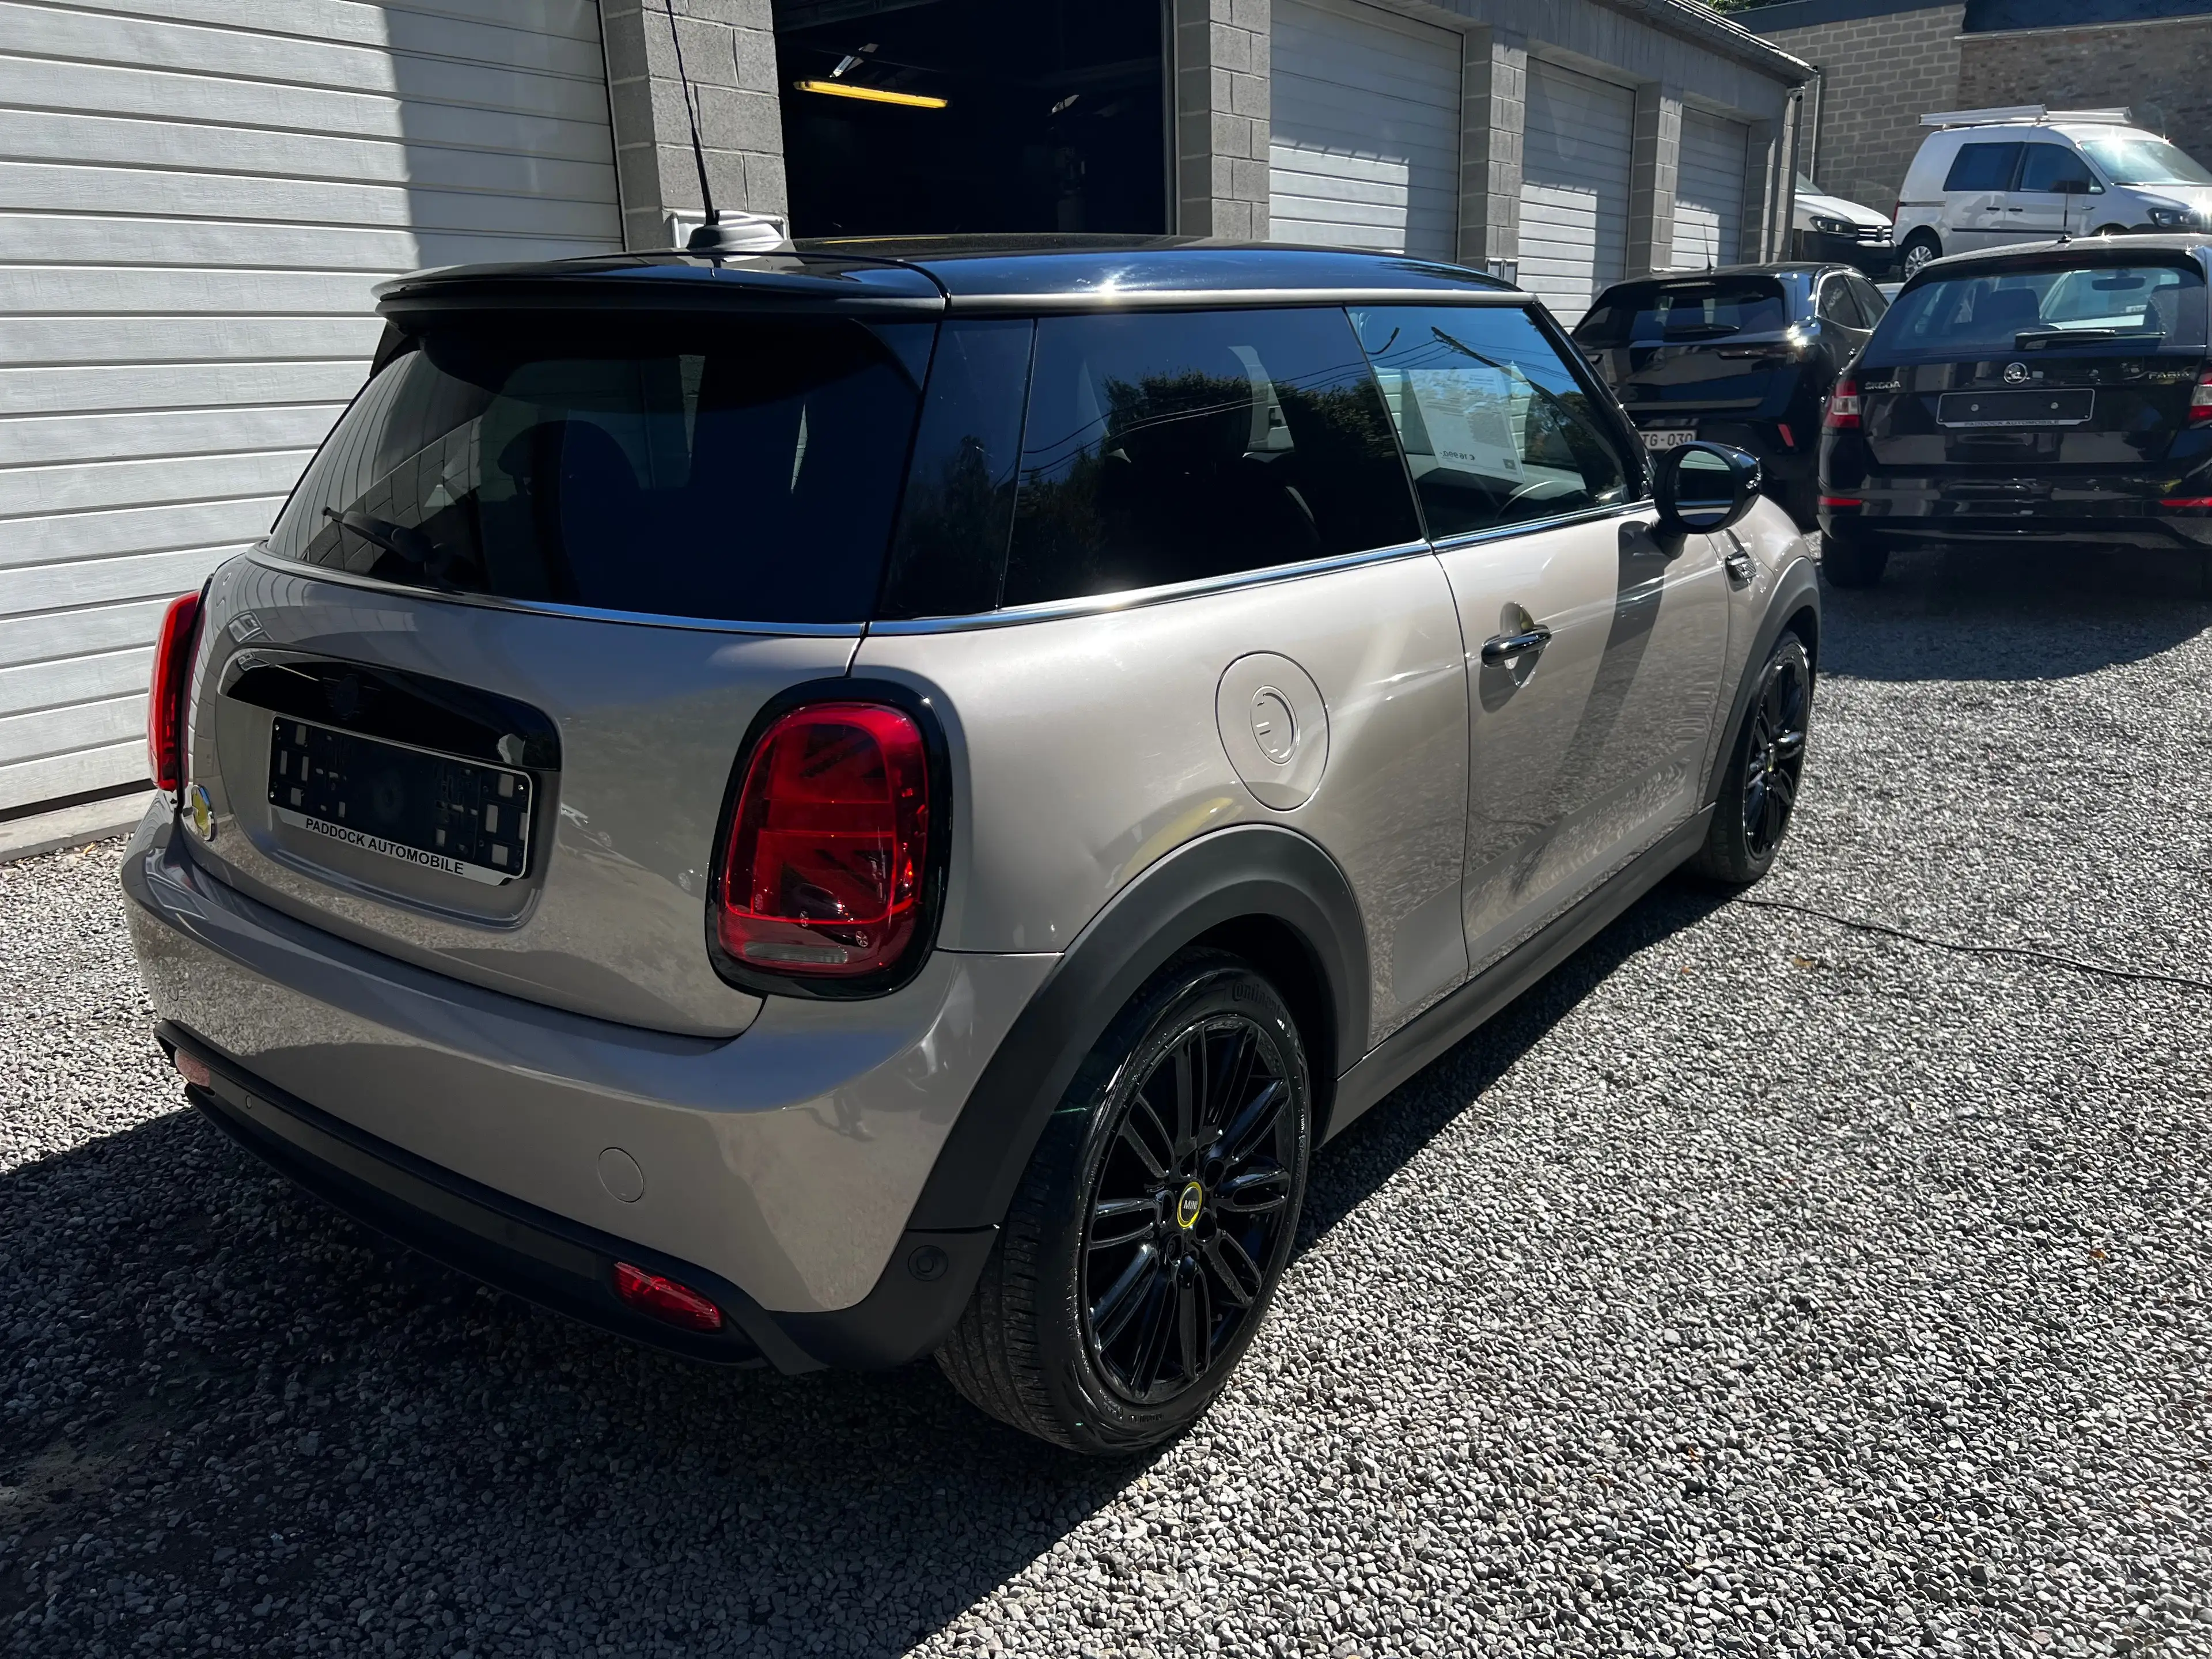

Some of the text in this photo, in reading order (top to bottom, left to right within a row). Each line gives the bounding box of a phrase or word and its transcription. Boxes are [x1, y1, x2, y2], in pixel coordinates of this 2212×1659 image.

[305, 817, 464, 875] PADDOCK AUTOMOBILE
[1183, 1200, 1198, 1210] MINI
